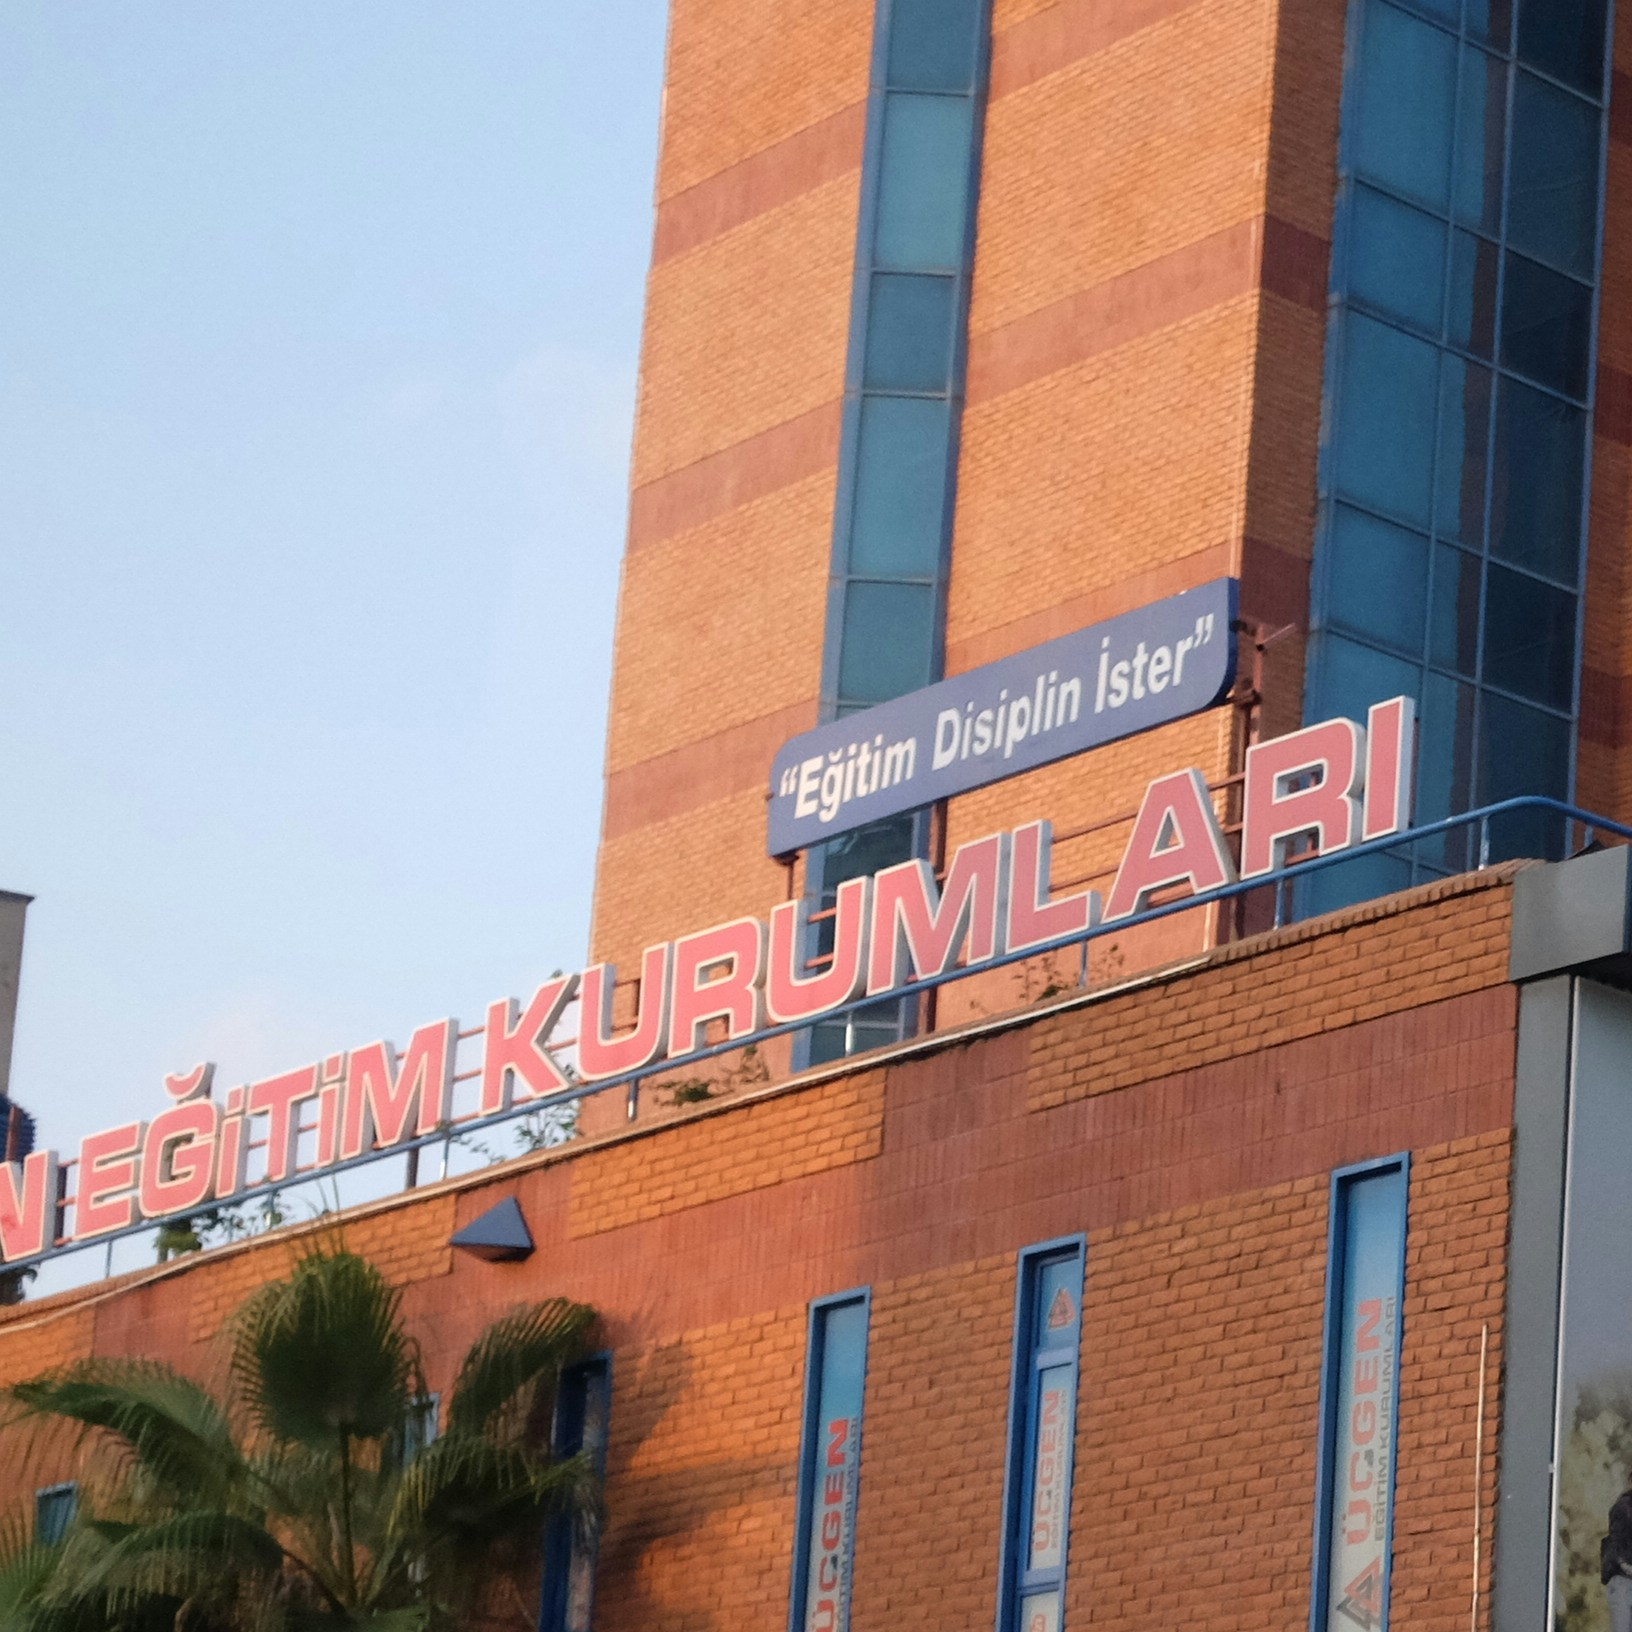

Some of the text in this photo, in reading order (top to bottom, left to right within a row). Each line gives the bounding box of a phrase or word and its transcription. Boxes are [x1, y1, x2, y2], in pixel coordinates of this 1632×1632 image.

[931, 677, 1081, 770] Disiplin
[73, 1016, 461, 1240] EĞİTİM
[480, 695, 1416, 1117] KURUMLARI
